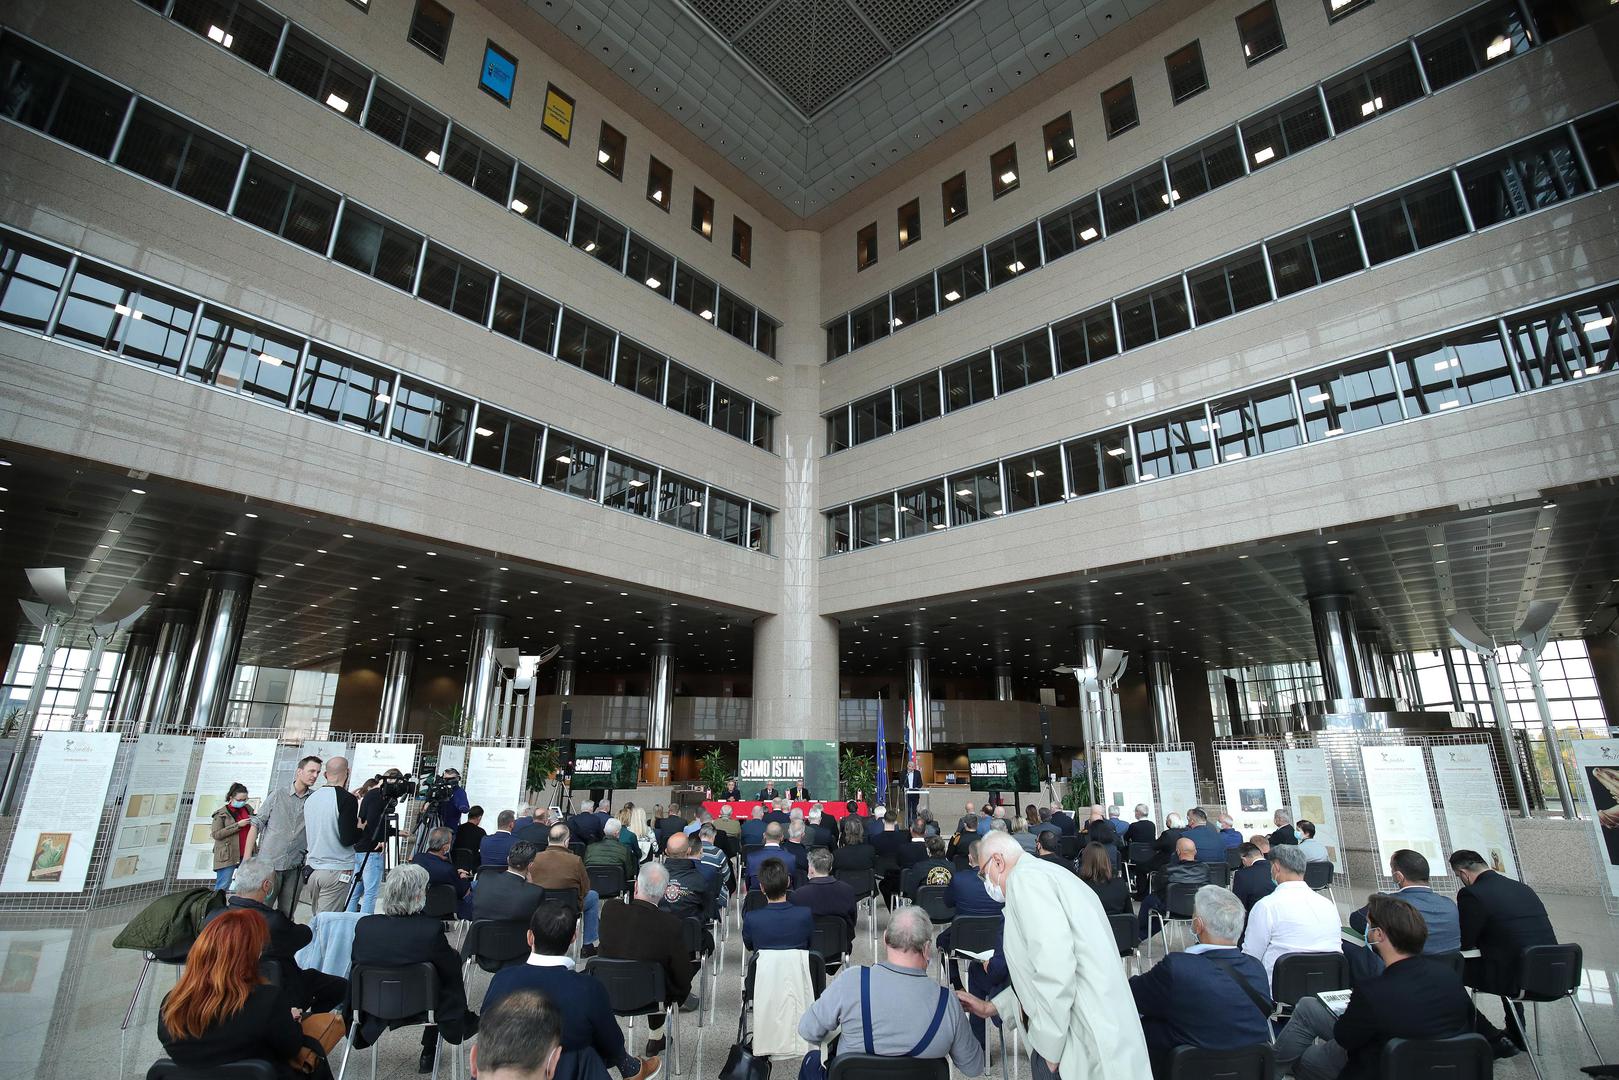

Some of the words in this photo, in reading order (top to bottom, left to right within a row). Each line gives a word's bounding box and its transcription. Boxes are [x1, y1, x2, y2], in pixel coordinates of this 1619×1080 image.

[575, 759, 593, 771] SAMO
[593, 759, 612, 771] ISTINA
[740, 759, 770, 778] SAMO
[772, 759, 804, 778] ISTINA
[970, 762, 987, 774] SAMO
[988, 762, 1007, 774] ISTINA
